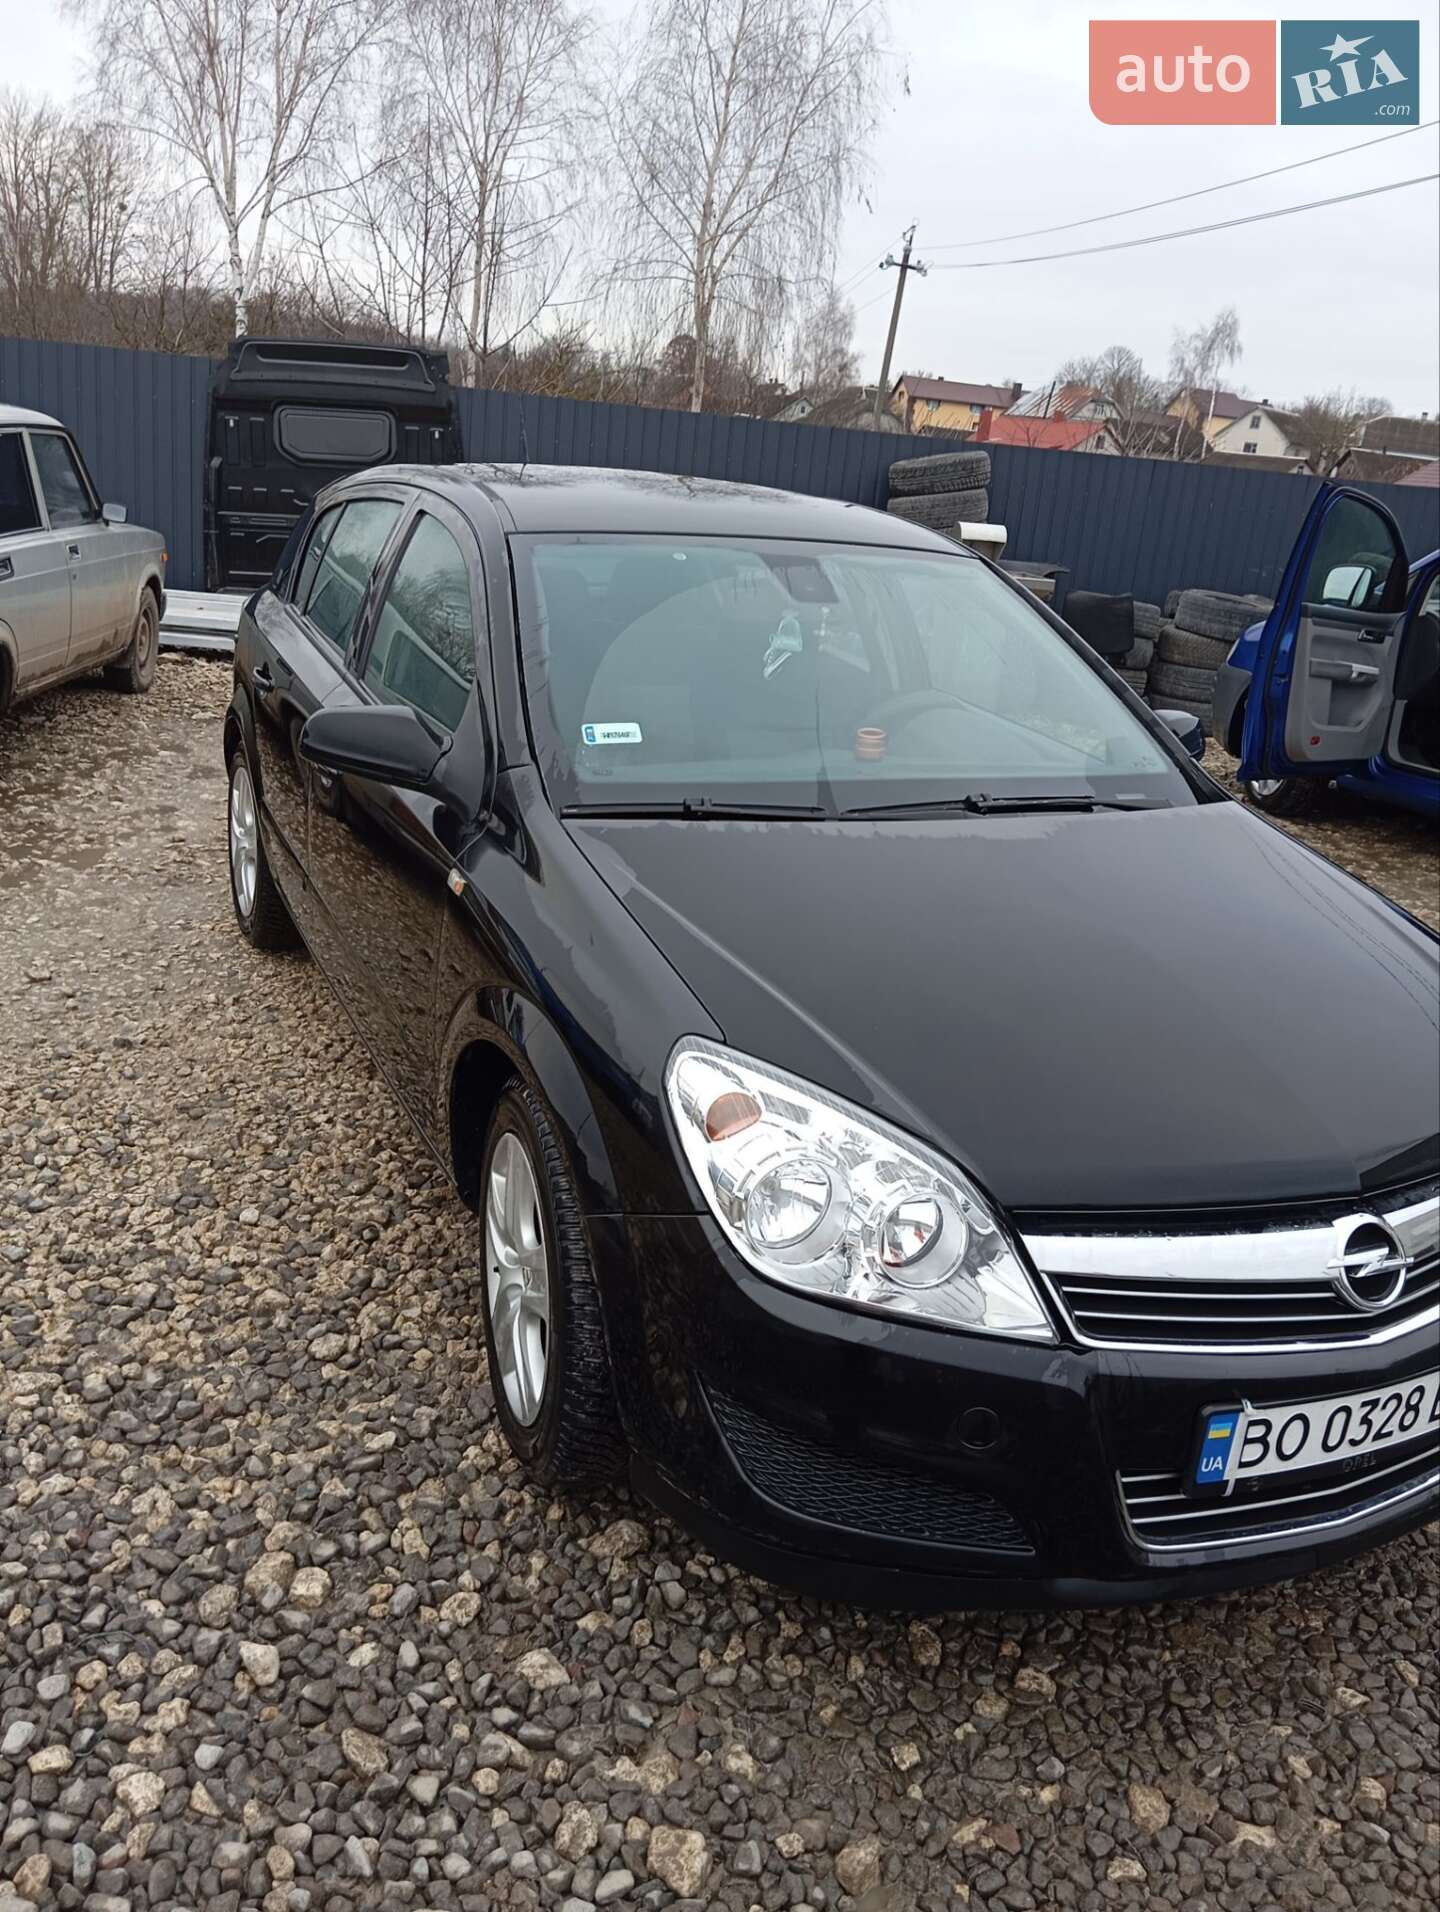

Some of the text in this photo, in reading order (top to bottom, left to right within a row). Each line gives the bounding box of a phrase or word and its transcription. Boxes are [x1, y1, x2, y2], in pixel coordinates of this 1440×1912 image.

[1238, 1412, 1310, 1469] BO
[1321, 1384, 1426, 1453] 0328
[1201, 1456, 1224, 1472] UA
